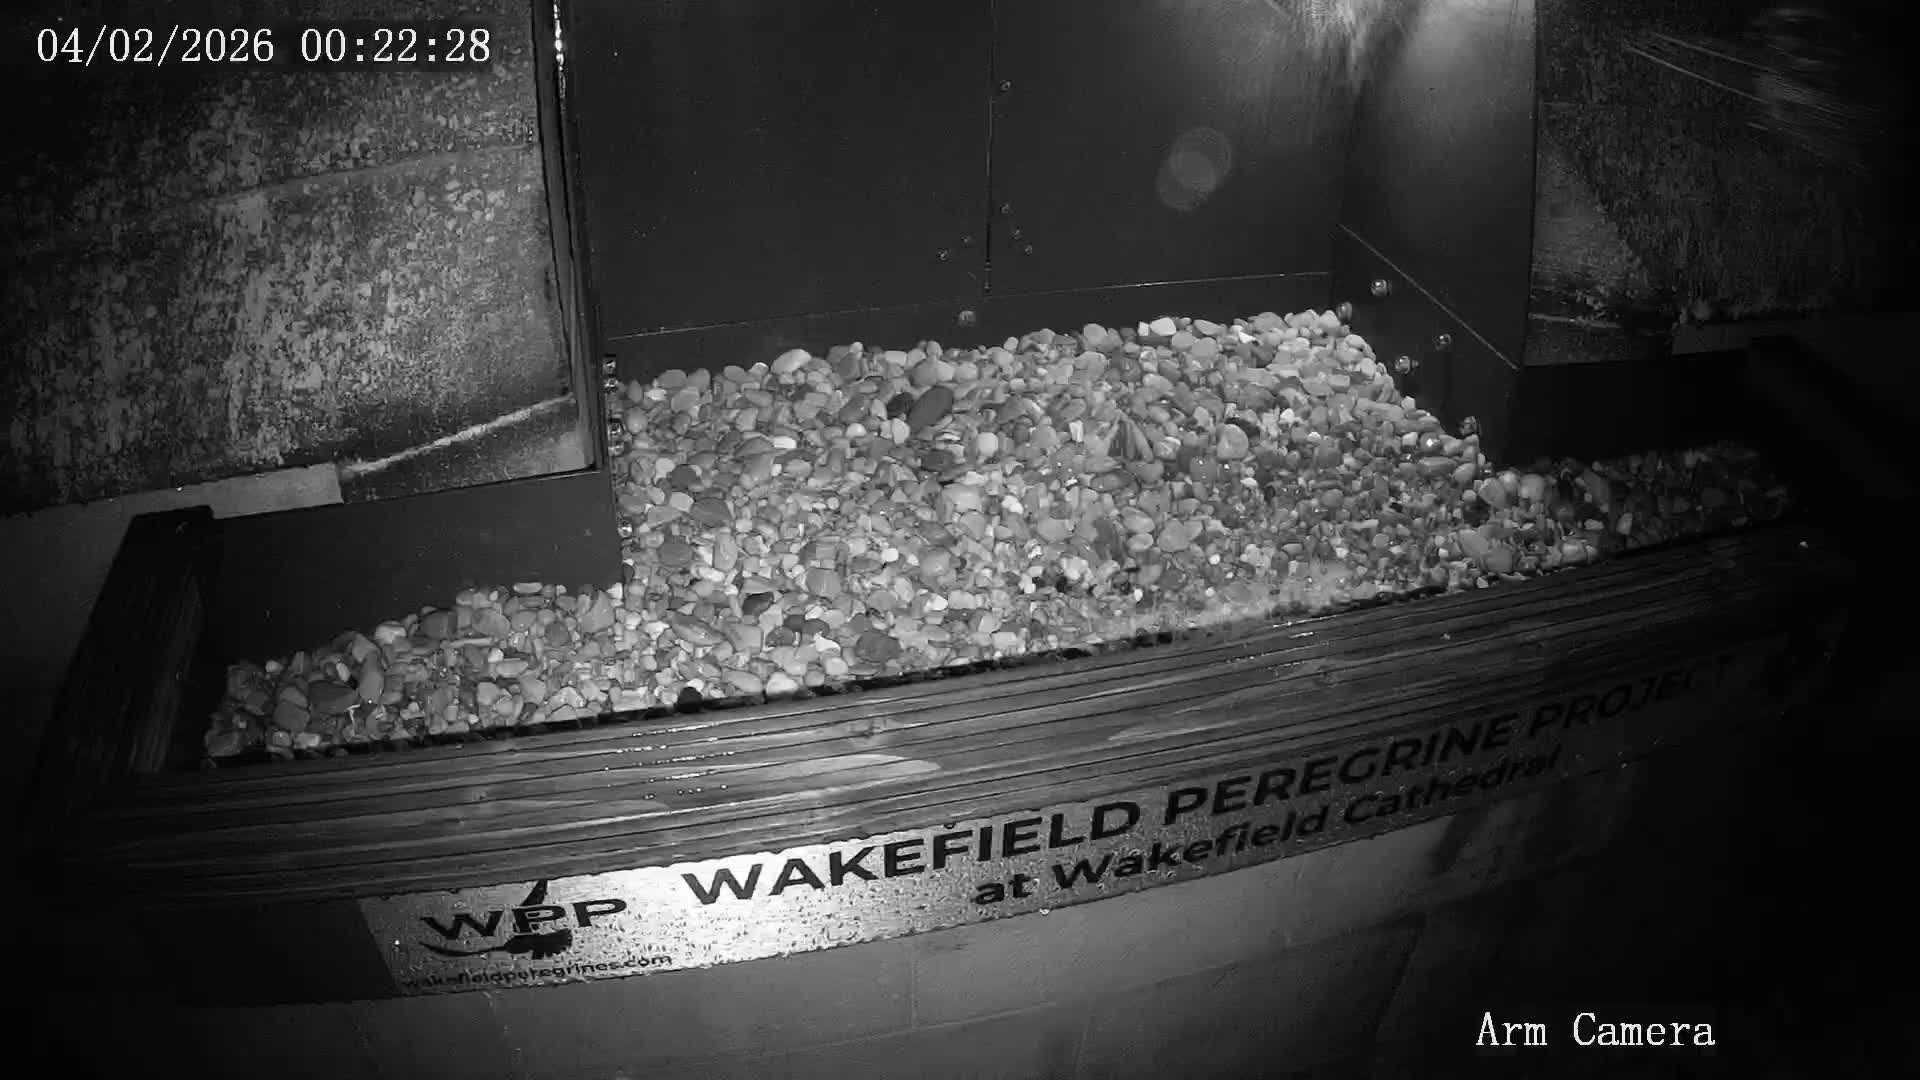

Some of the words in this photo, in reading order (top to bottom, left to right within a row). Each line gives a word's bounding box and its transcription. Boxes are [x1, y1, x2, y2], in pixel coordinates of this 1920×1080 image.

[682, 801, 1141, 906] WAKEFIELD
[1164, 711, 1521, 825] PEREGRINE
[975, 873, 1032, 905] at
[1052, 806, 1328, 890] Wakefield
[1344, 745, 1562, 824] Cathedral
[420, 897, 626, 941] WPP
